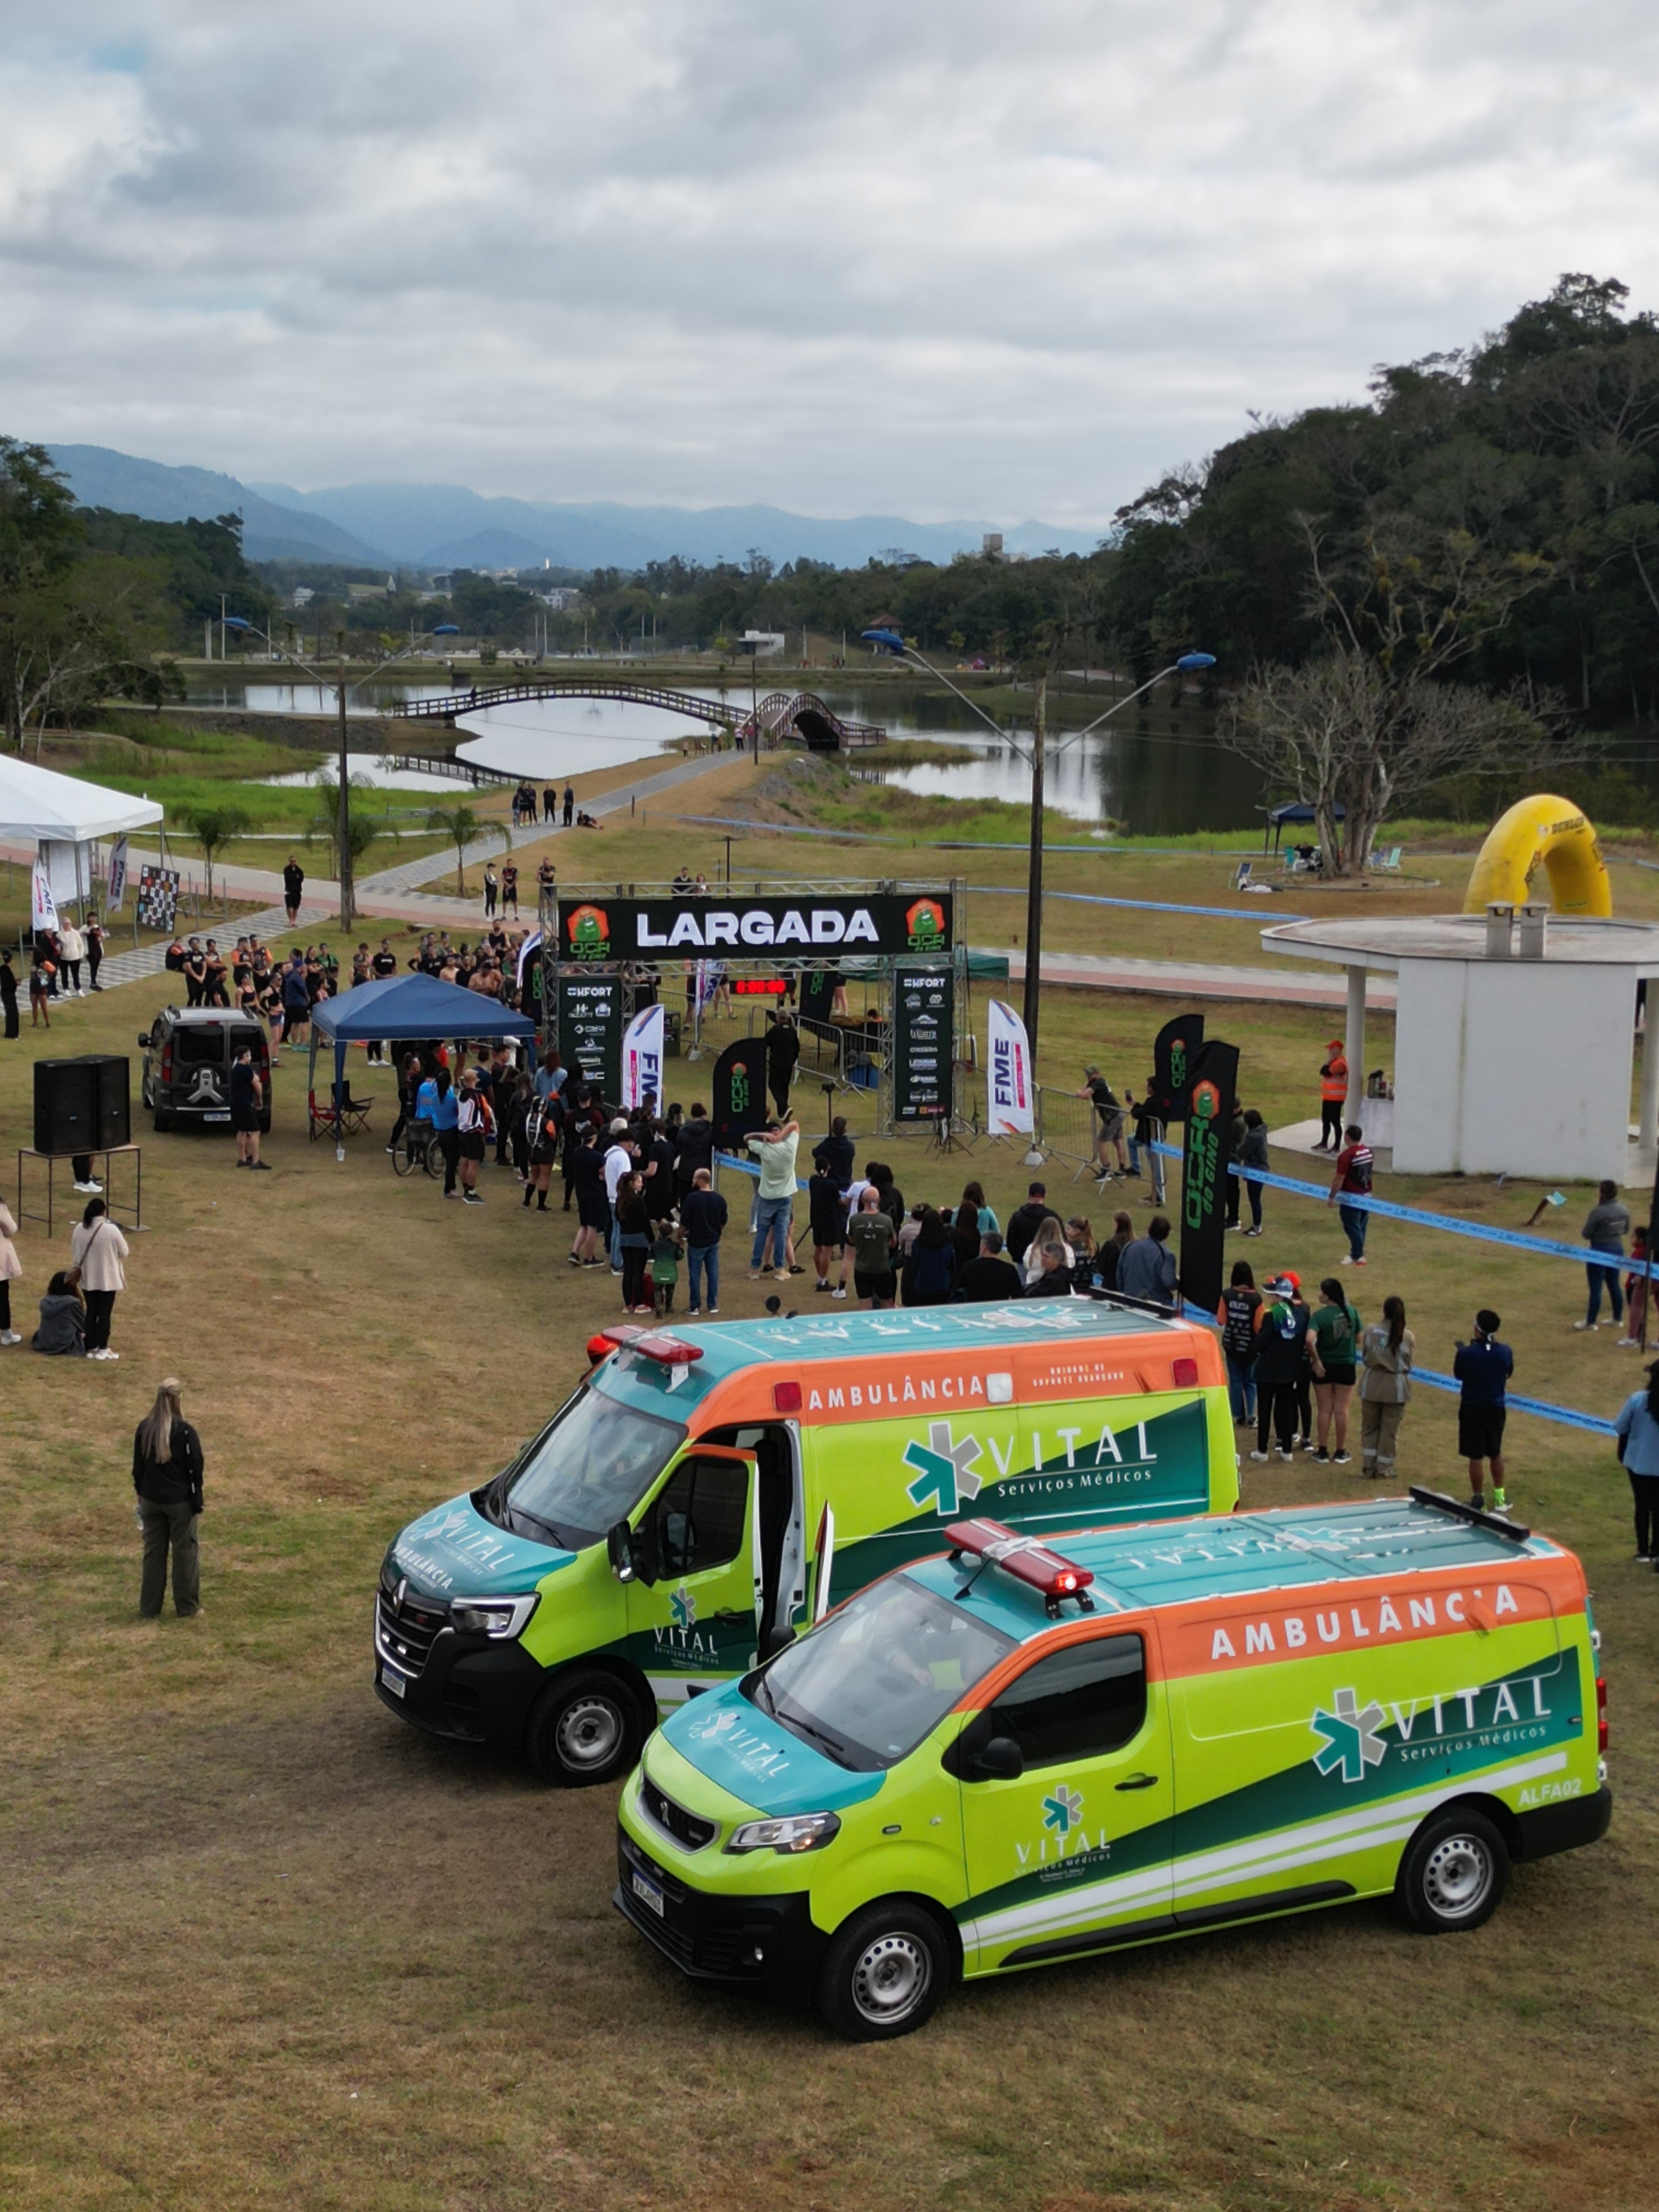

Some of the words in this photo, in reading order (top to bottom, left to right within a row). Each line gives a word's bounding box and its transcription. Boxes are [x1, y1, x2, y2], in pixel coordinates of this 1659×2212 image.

[637, 909, 879, 947] LARGADA
[908, 933, 945, 947] OCR
[570, 942, 610, 954] OCR
[736, 979, 786, 994] 0:00:00
[641, 1052, 658, 1115] FM
[994, 1037, 1012, 1107] FME
[731, 1075, 743, 1113] OCR
[1186, 1115, 1210, 1229] OCR
[809, 1375, 984, 1410] AMBULÂNCIA
[988, 1421, 1157, 1476] VITAL
[998, 1478, 1074, 1497] Serviços
[1080, 1470, 1152, 1487] Médicos
[446, 1523, 515, 1571] VITAL
[653, 1623, 718, 1655] VITAL
[1211, 1584, 1518, 1660] AMBULÂNCA
[1390, 1677, 1552, 1740] VITAL
[728, 1728, 790, 1778] VITAL
[1400, 1740, 1473, 1762] Serviços
[1478, 1725, 1547, 1747] Médicos
[1519, 1778, 1582, 1807] ALFA02
[1015, 1829, 1110, 1864] VITAL
